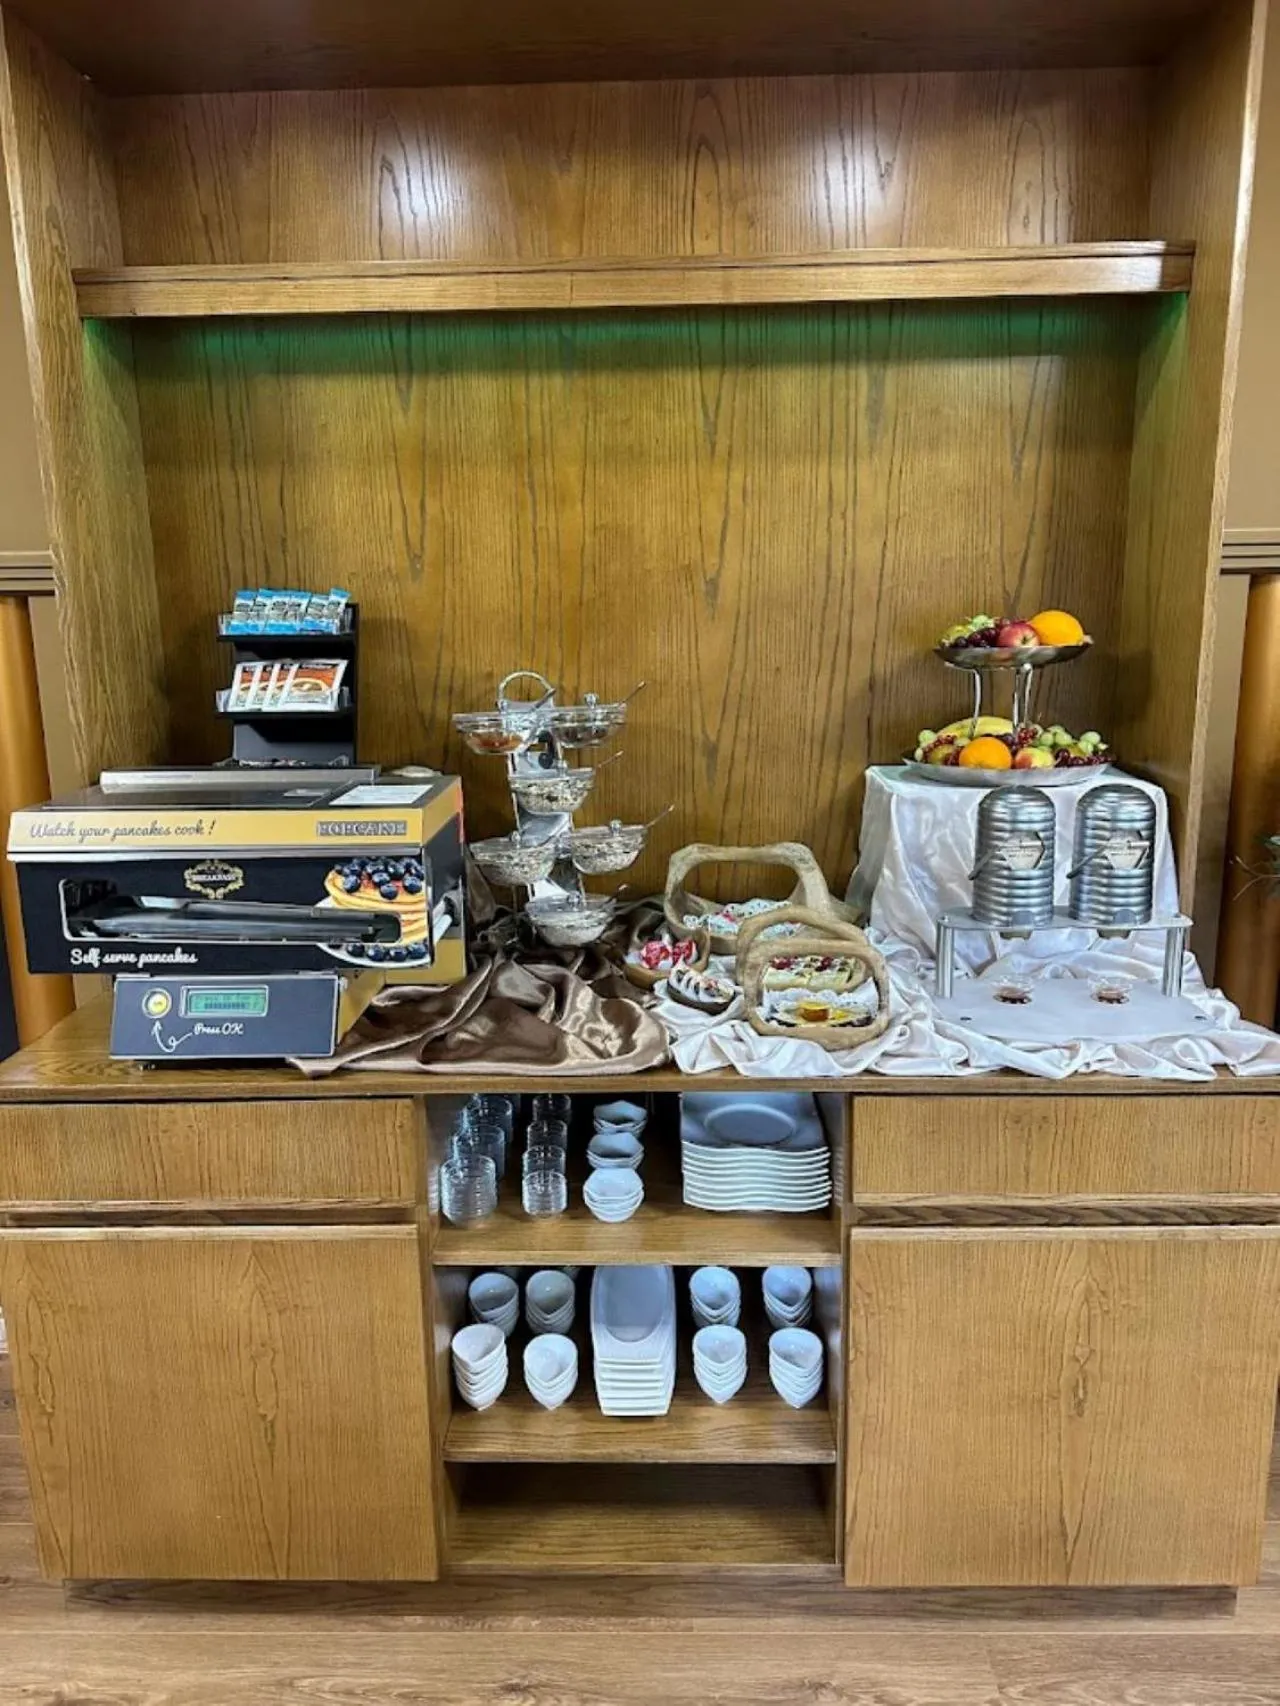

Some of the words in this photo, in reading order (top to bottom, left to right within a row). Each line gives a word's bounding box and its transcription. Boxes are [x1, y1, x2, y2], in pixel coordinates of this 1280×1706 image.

[30, 820, 75, 838] Watch
[79, 824, 110, 843] your
[111, 820, 171, 841] pancakes
[174, 819, 204, 836] cook
[70, 946, 100, 968] Self
[102, 953, 138, 963] serve
[137, 946, 198, 968] pancakes
[194, 1022, 221, 1035] Press
[221, 1022, 244, 1035] OK
